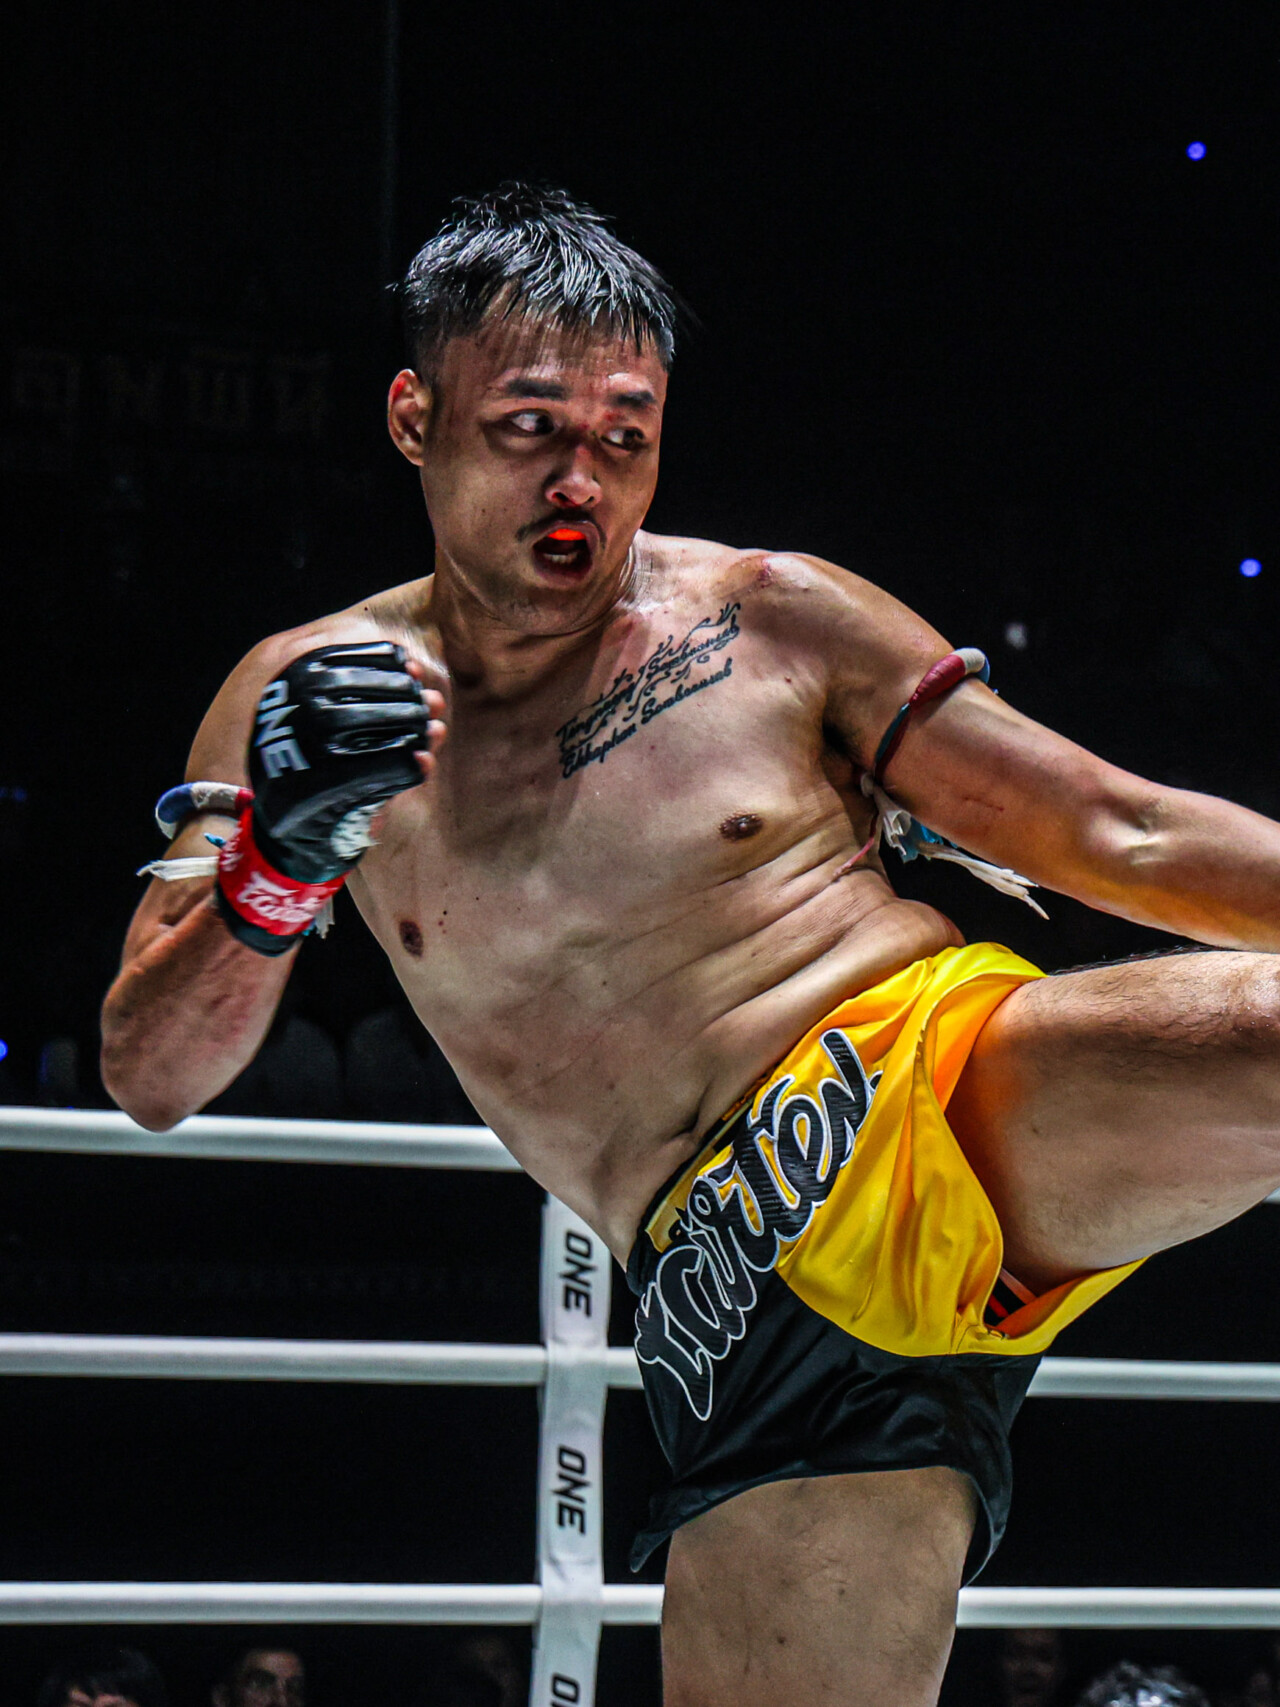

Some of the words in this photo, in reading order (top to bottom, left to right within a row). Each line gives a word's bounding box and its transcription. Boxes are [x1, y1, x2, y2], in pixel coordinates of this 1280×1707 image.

[253, 679, 311, 779] ONE
[559, 1229, 599, 1319] ONE
[552, 1445, 592, 1535] ONE
